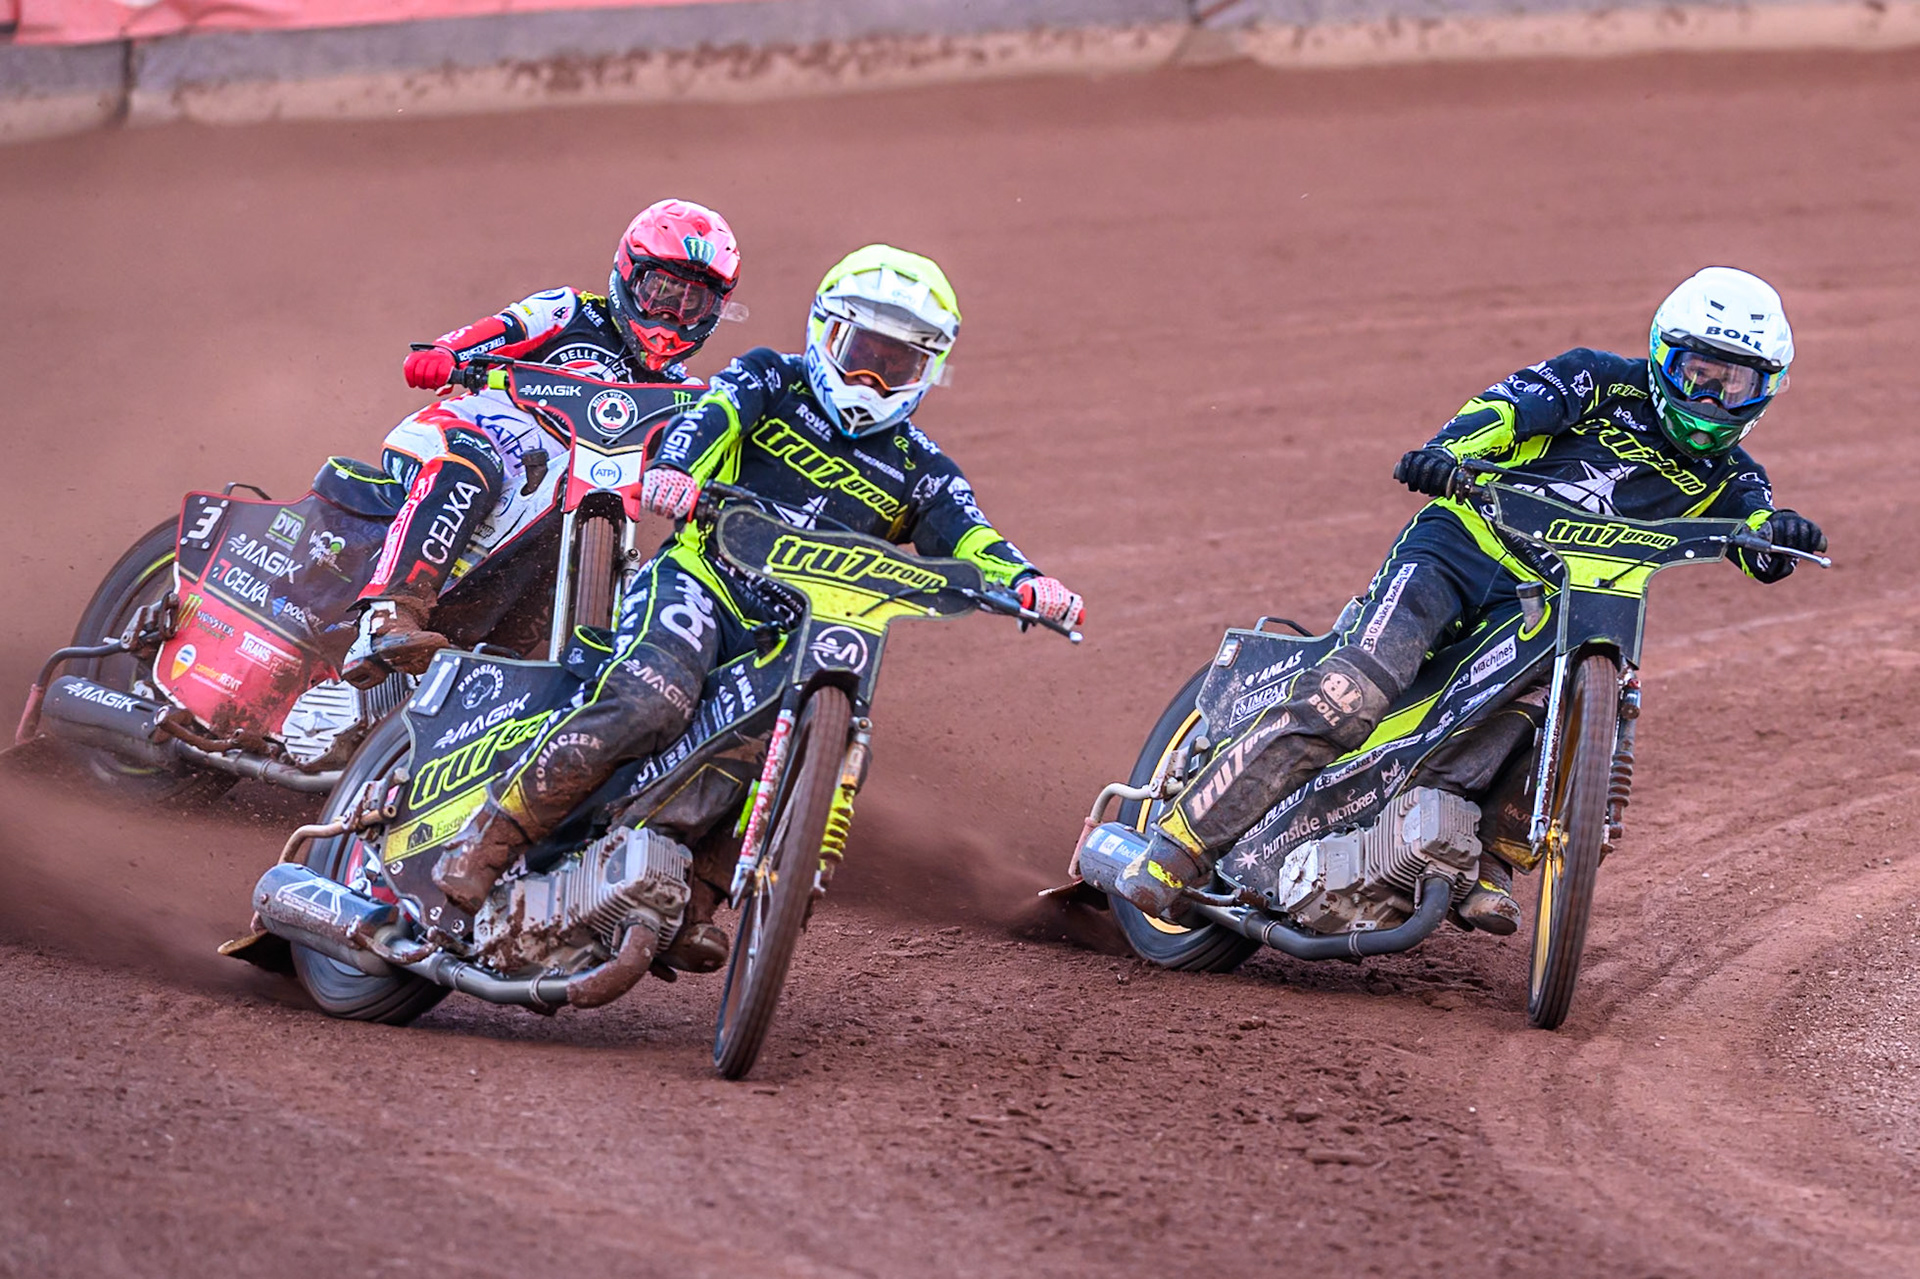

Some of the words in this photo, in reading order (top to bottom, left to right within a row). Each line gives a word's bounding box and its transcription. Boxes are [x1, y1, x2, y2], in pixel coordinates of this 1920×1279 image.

[559, 349, 599, 363] BELLE
[1705, 326, 1764, 353] BOLL
[594, 469, 616, 479] ATPI
[187, 505, 222, 540] 3
[273, 513, 301, 541] DVR
[421, 480, 482, 565] CELKA
[223, 566, 272, 608] CELKA
[1218, 643, 1236, 662] 5
[1258, 650, 1304, 684] ANLAS
[1472, 641, 1514, 676] Machines
[1307, 693, 1342, 728] BOLL
[1325, 787, 1379, 825] MOTOREX
[1261, 814, 1322, 861] burnside
